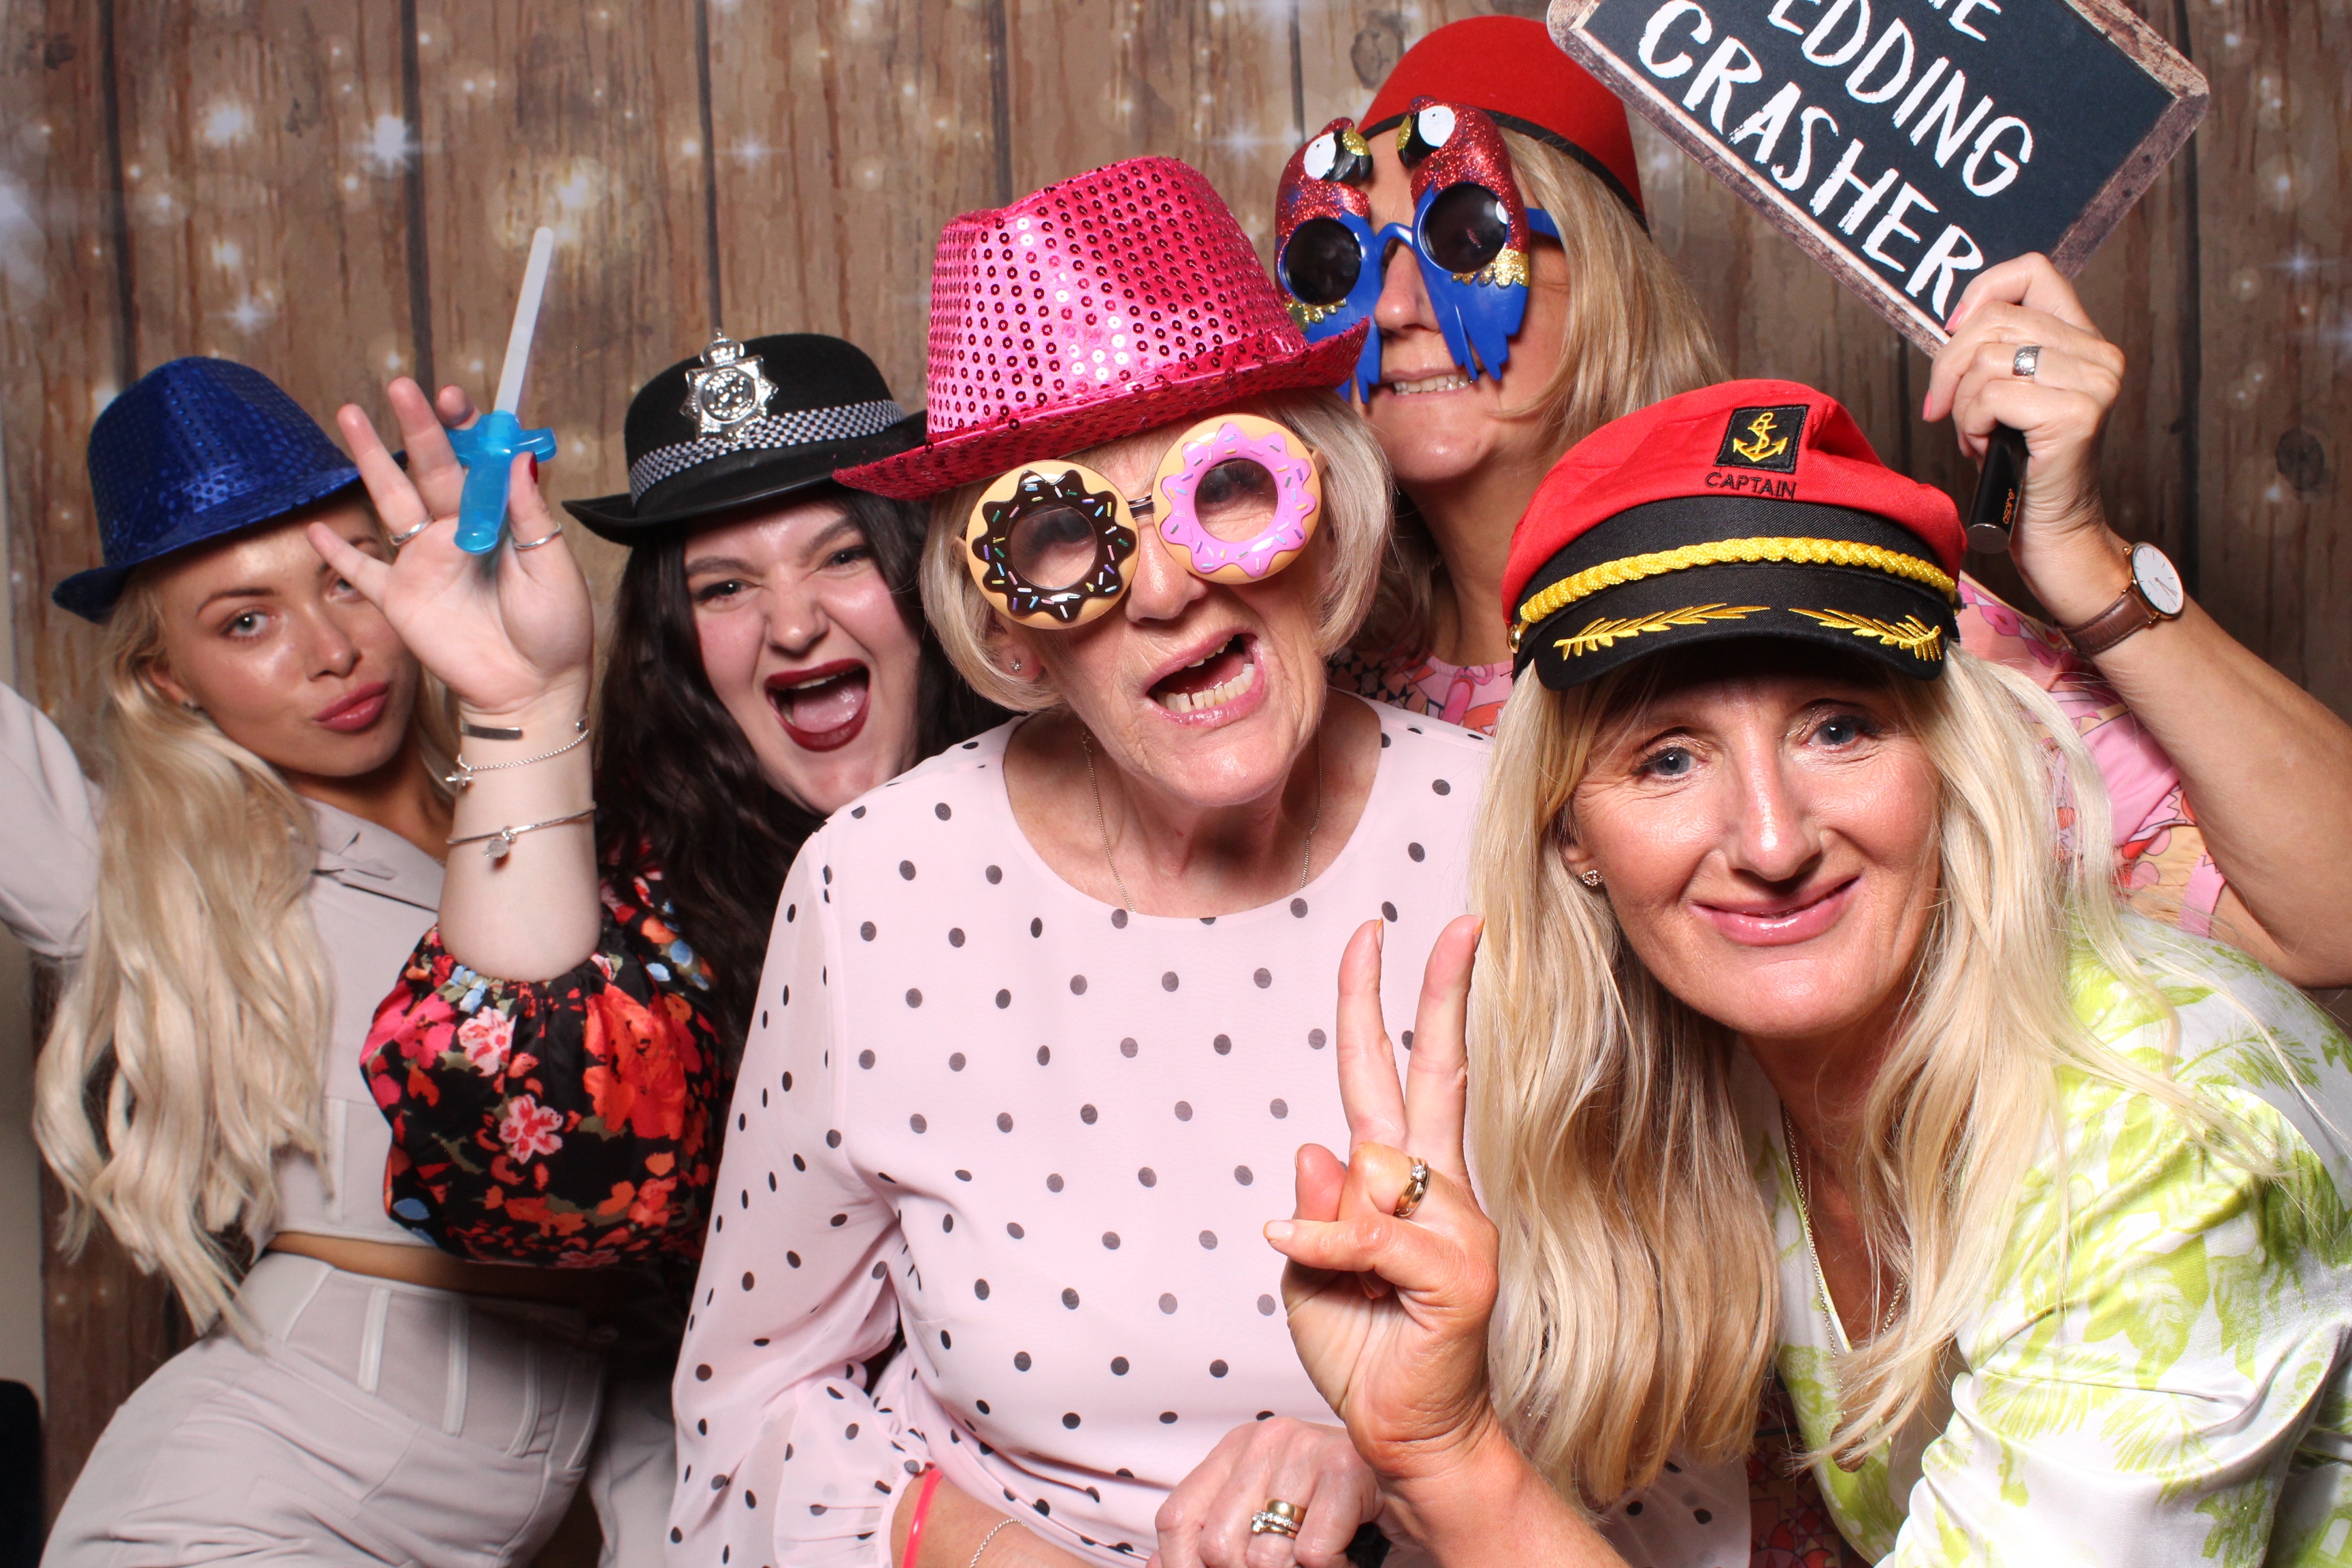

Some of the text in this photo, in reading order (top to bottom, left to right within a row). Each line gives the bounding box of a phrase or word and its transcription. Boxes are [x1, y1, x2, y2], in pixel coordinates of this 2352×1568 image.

[1637, 0, 1984, 321] CRASHER
[1767, 0, 2034, 197] EDDING
[1705, 472, 1797, 500] CAPTAIN
